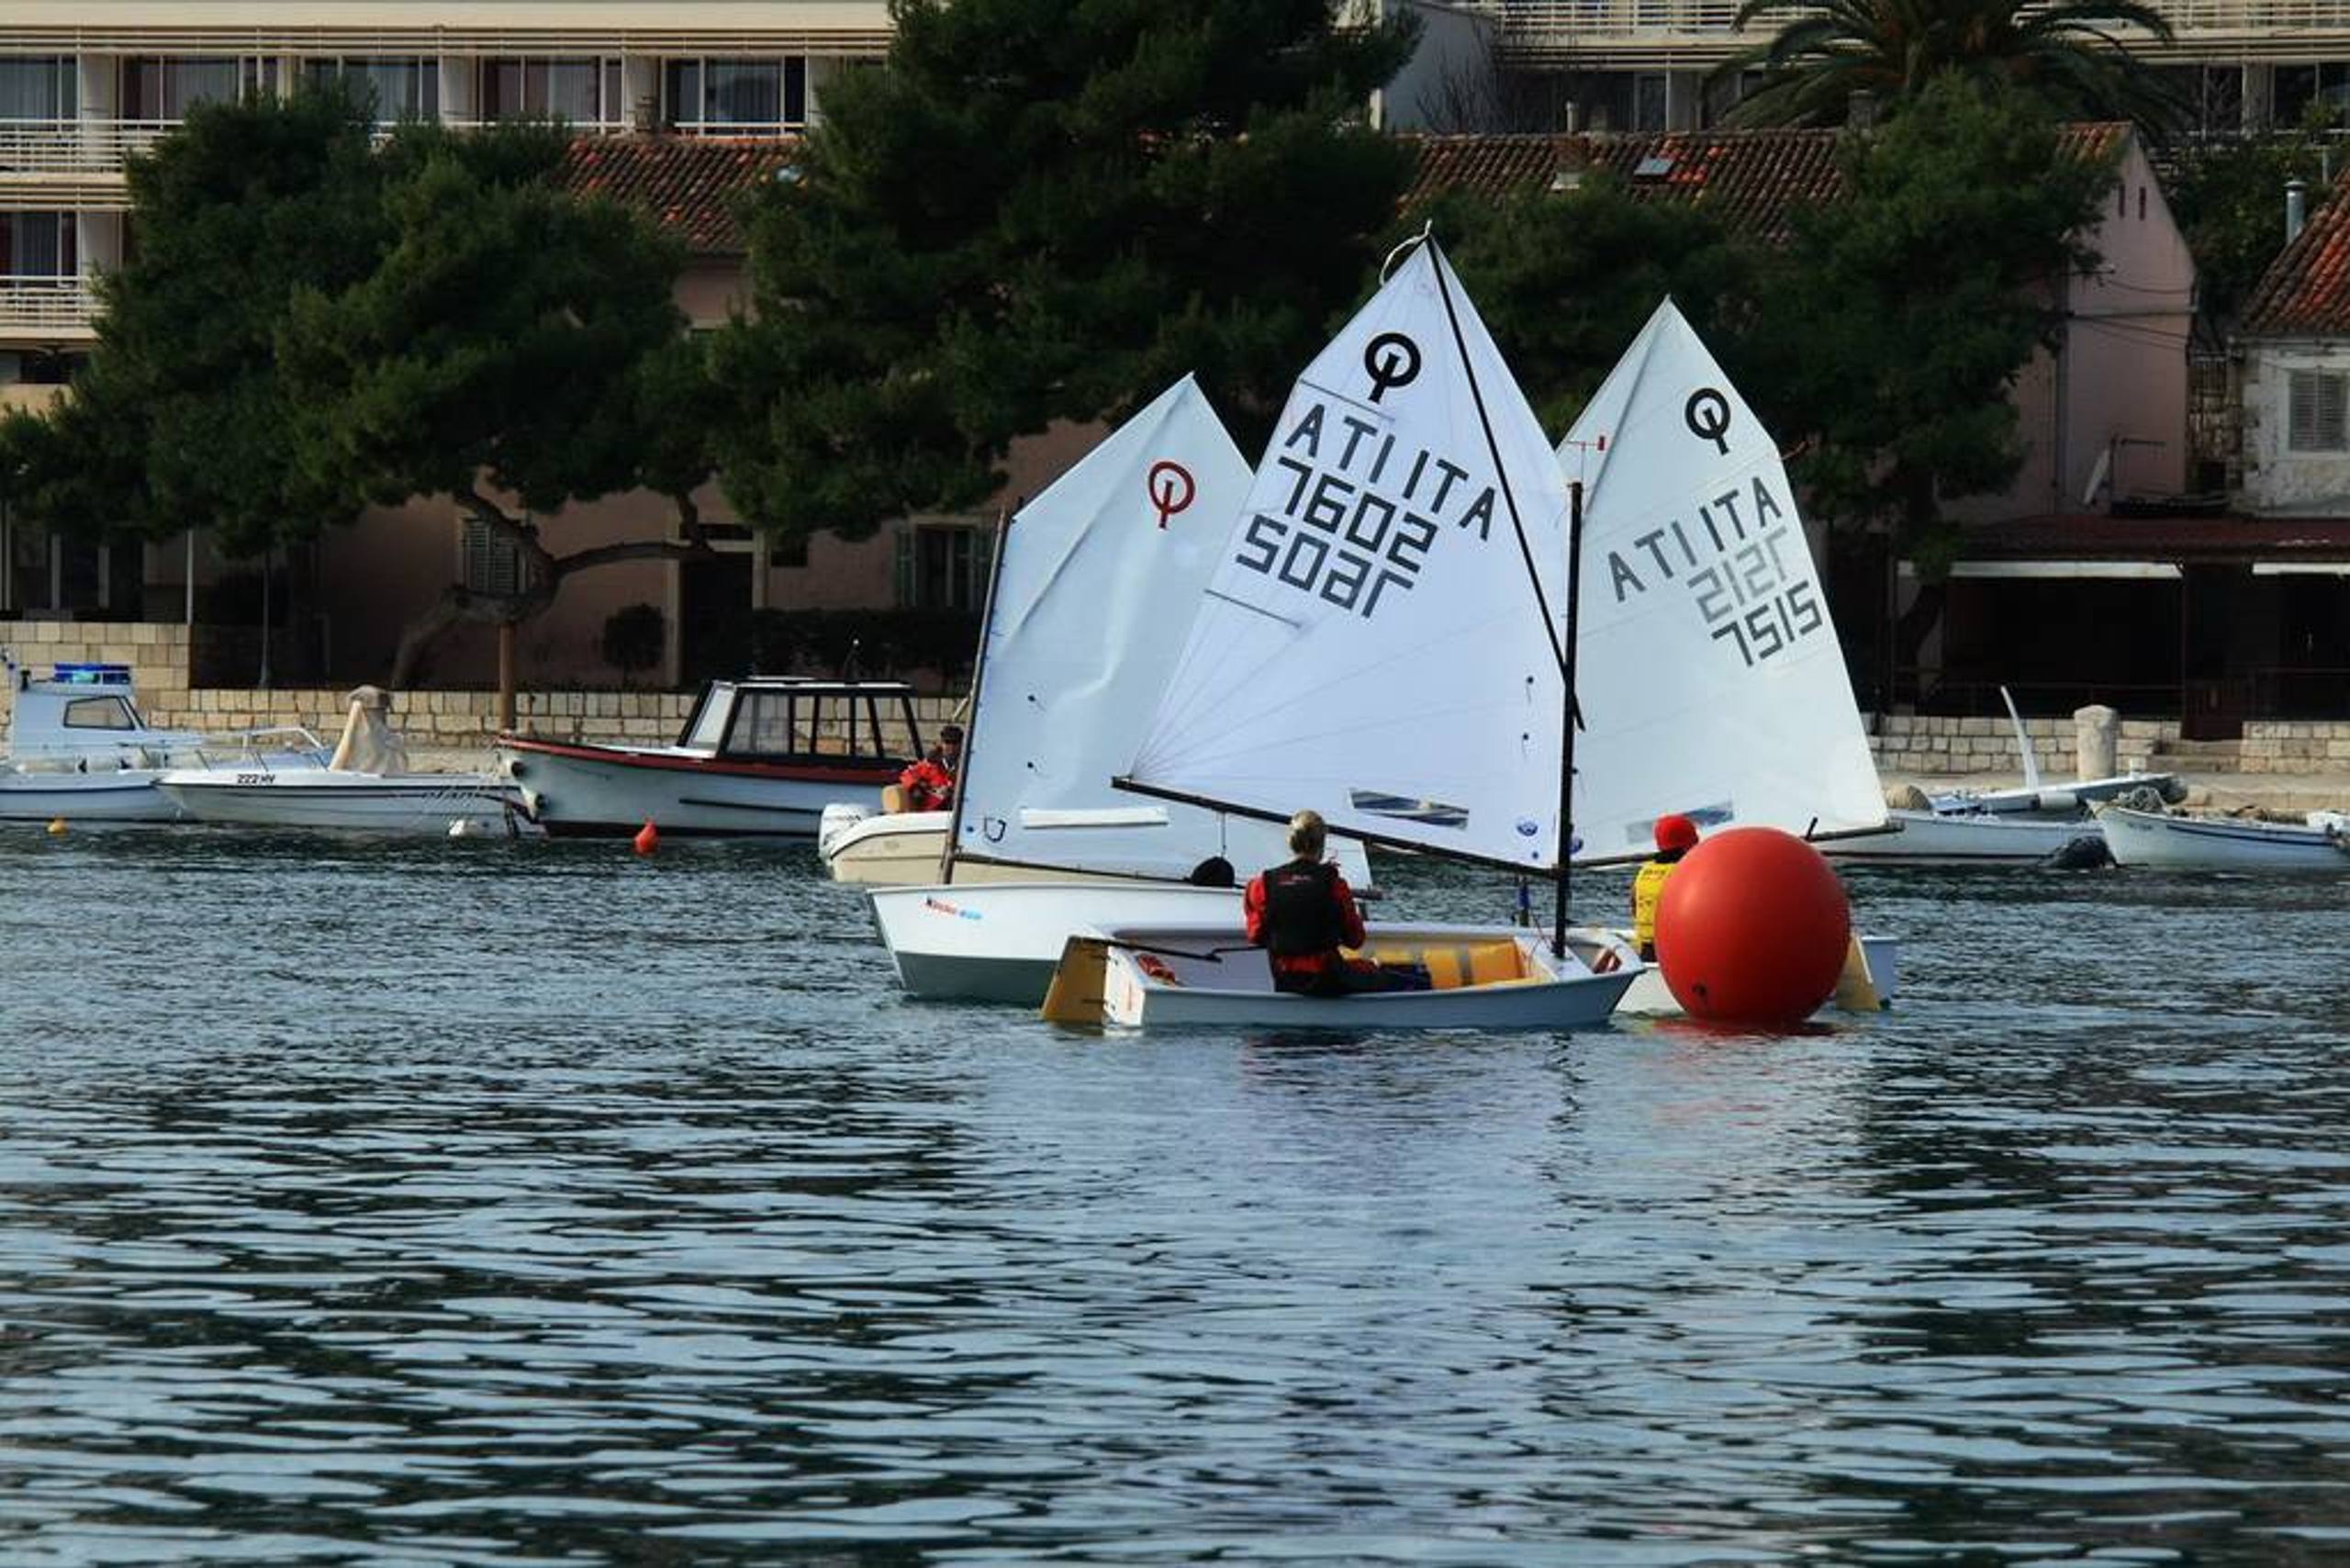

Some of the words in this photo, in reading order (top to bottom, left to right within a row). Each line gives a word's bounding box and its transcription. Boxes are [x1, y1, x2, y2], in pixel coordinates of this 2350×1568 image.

[1278, 456, 1438, 574] 7602
[1402, 450, 1495, 542] ITA
[1699, 476, 1782, 552] ITA
[1711, 580, 1822, 666] 7515
